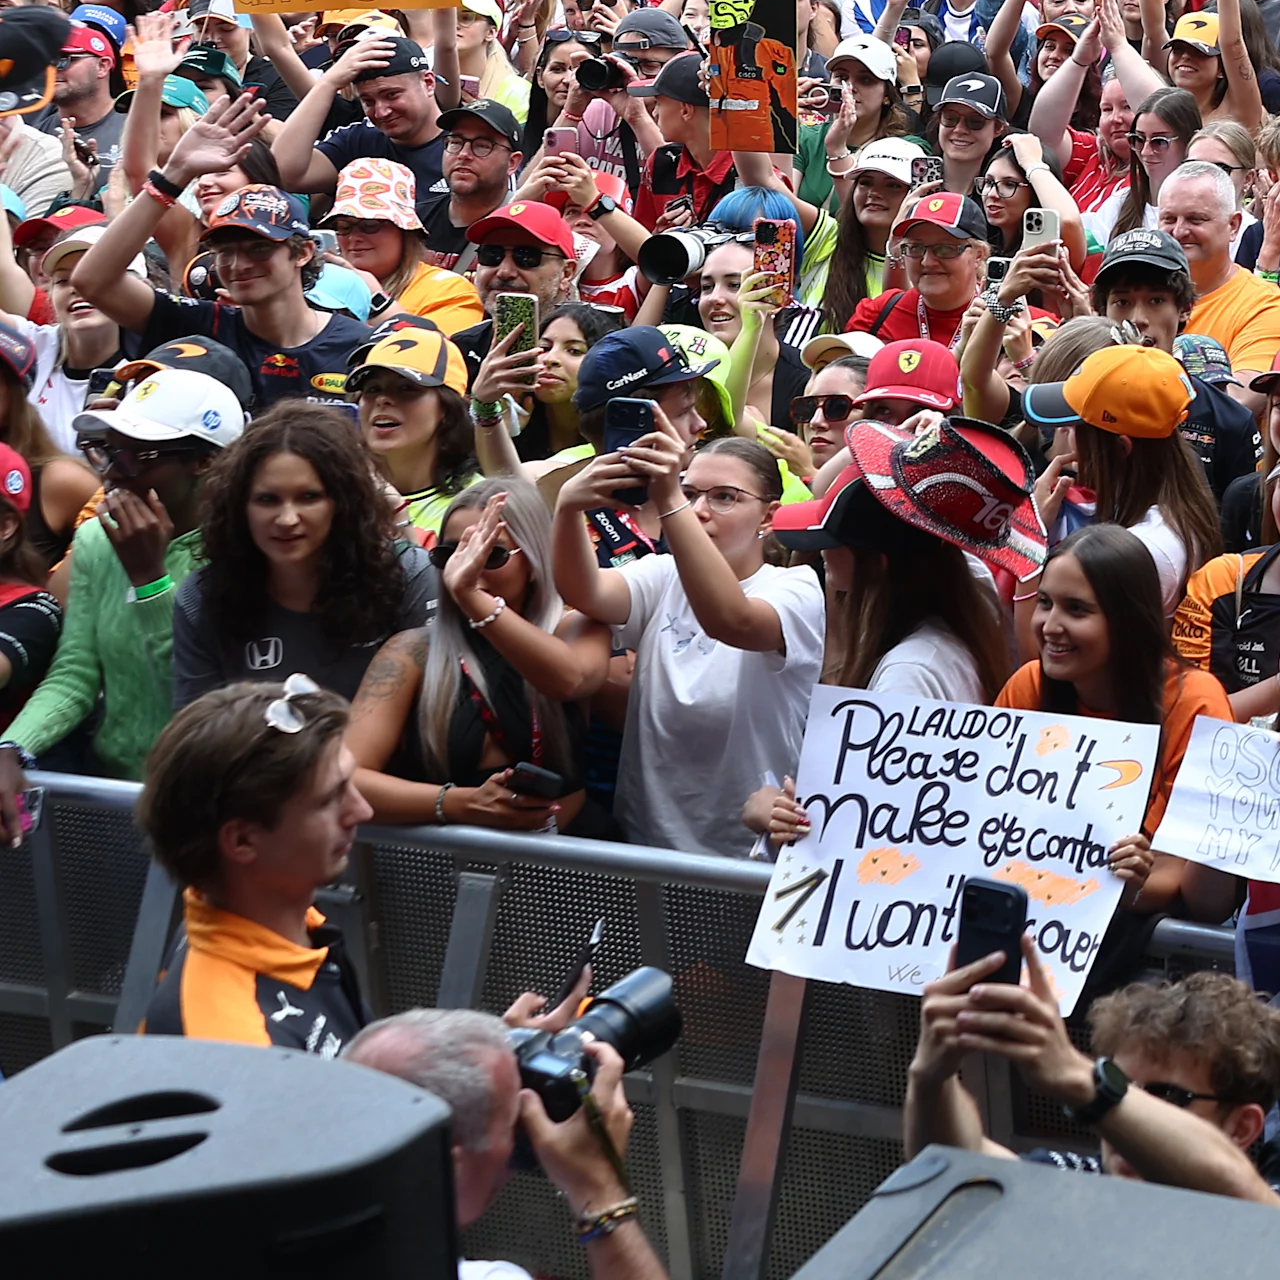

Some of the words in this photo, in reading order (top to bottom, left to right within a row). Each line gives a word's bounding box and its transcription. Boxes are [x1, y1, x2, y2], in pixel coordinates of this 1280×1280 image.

[606, 368, 648, 390] CarNext
[595, 511, 621, 543] zoom
[831, 699, 980, 786] Please
[985, 734, 1098, 810] don't
[978, 813, 1026, 868] eye
[1196, 824, 1261, 865] MY
